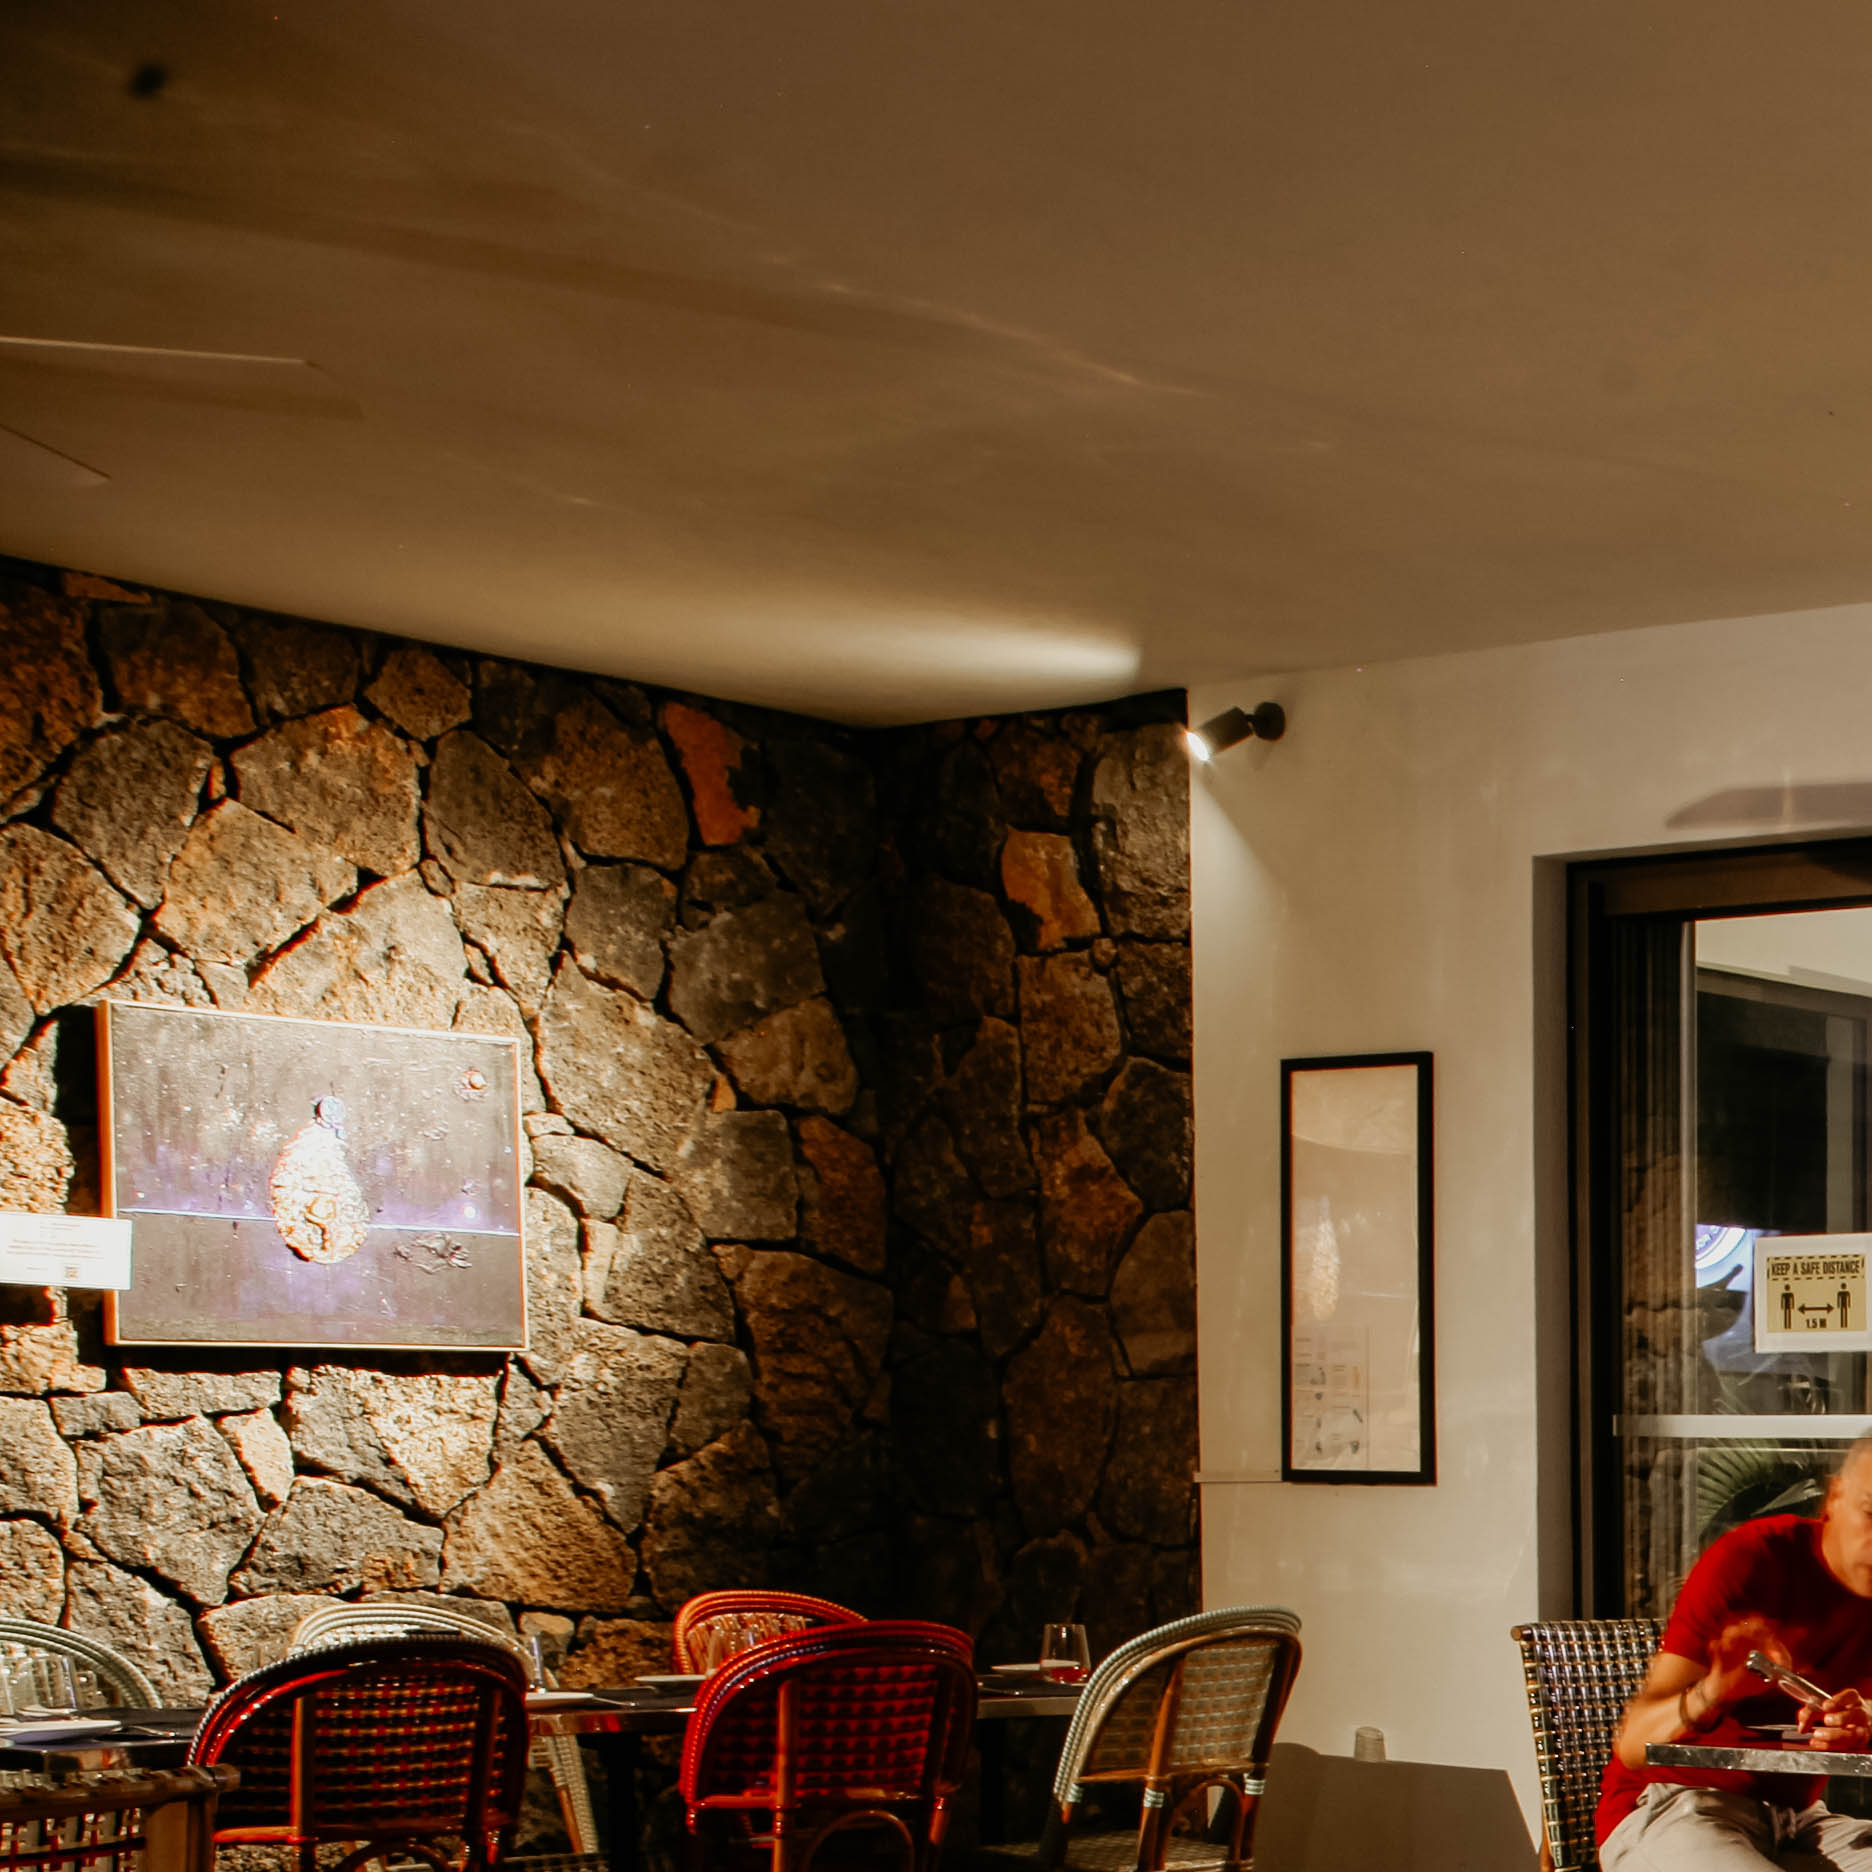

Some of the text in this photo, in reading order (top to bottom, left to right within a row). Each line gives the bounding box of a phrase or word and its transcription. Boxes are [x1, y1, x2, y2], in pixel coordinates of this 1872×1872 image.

[1771, 1260, 1860, 1276] KEEP A SAFE DISTANCE
[1806, 1318, 1817, 1329] 1.5
